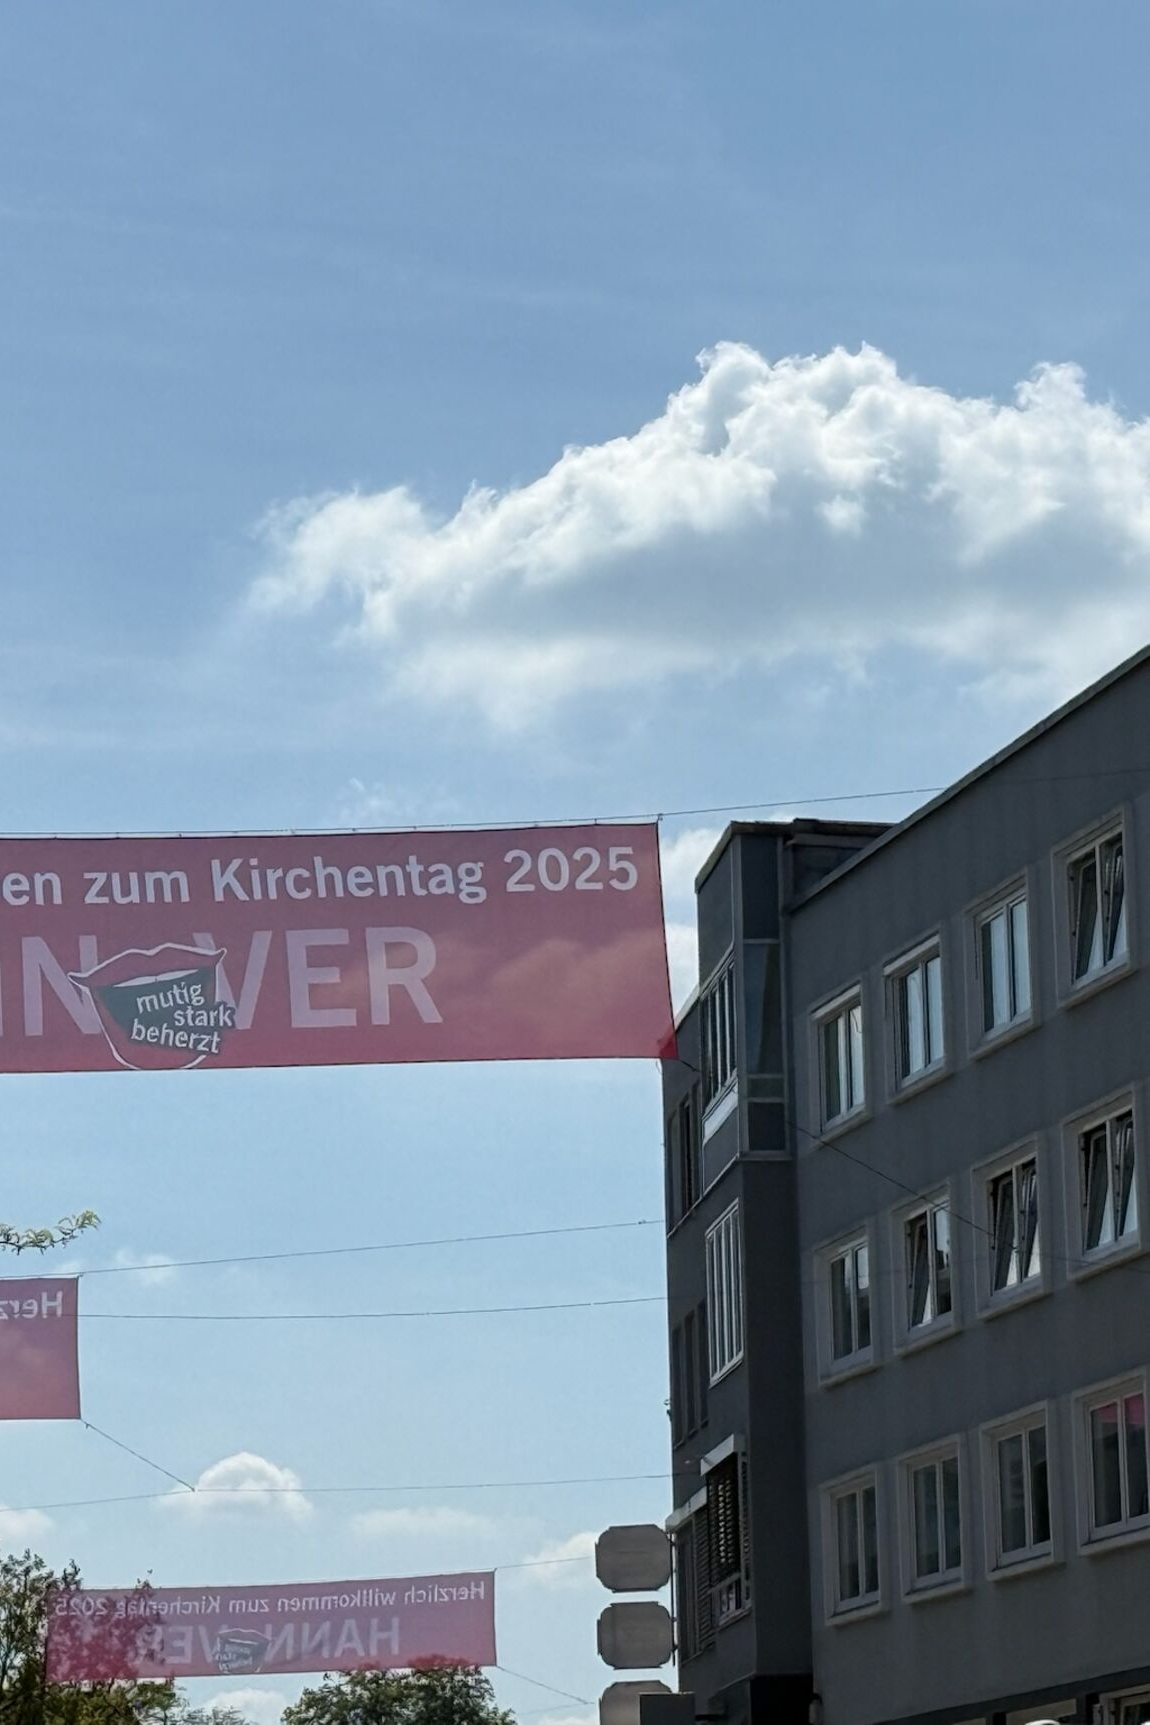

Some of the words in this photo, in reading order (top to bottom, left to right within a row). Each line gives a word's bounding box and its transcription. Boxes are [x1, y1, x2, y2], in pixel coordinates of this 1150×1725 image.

[83, 869, 190, 905] zum
[210, 856, 487, 905] Kirchentag
[503, 845, 639, 893] 2025
[136, 982, 205, 1014] mutig
[173, 1004, 234, 1028] stark
[130, 1018, 221, 1054] beherzt
